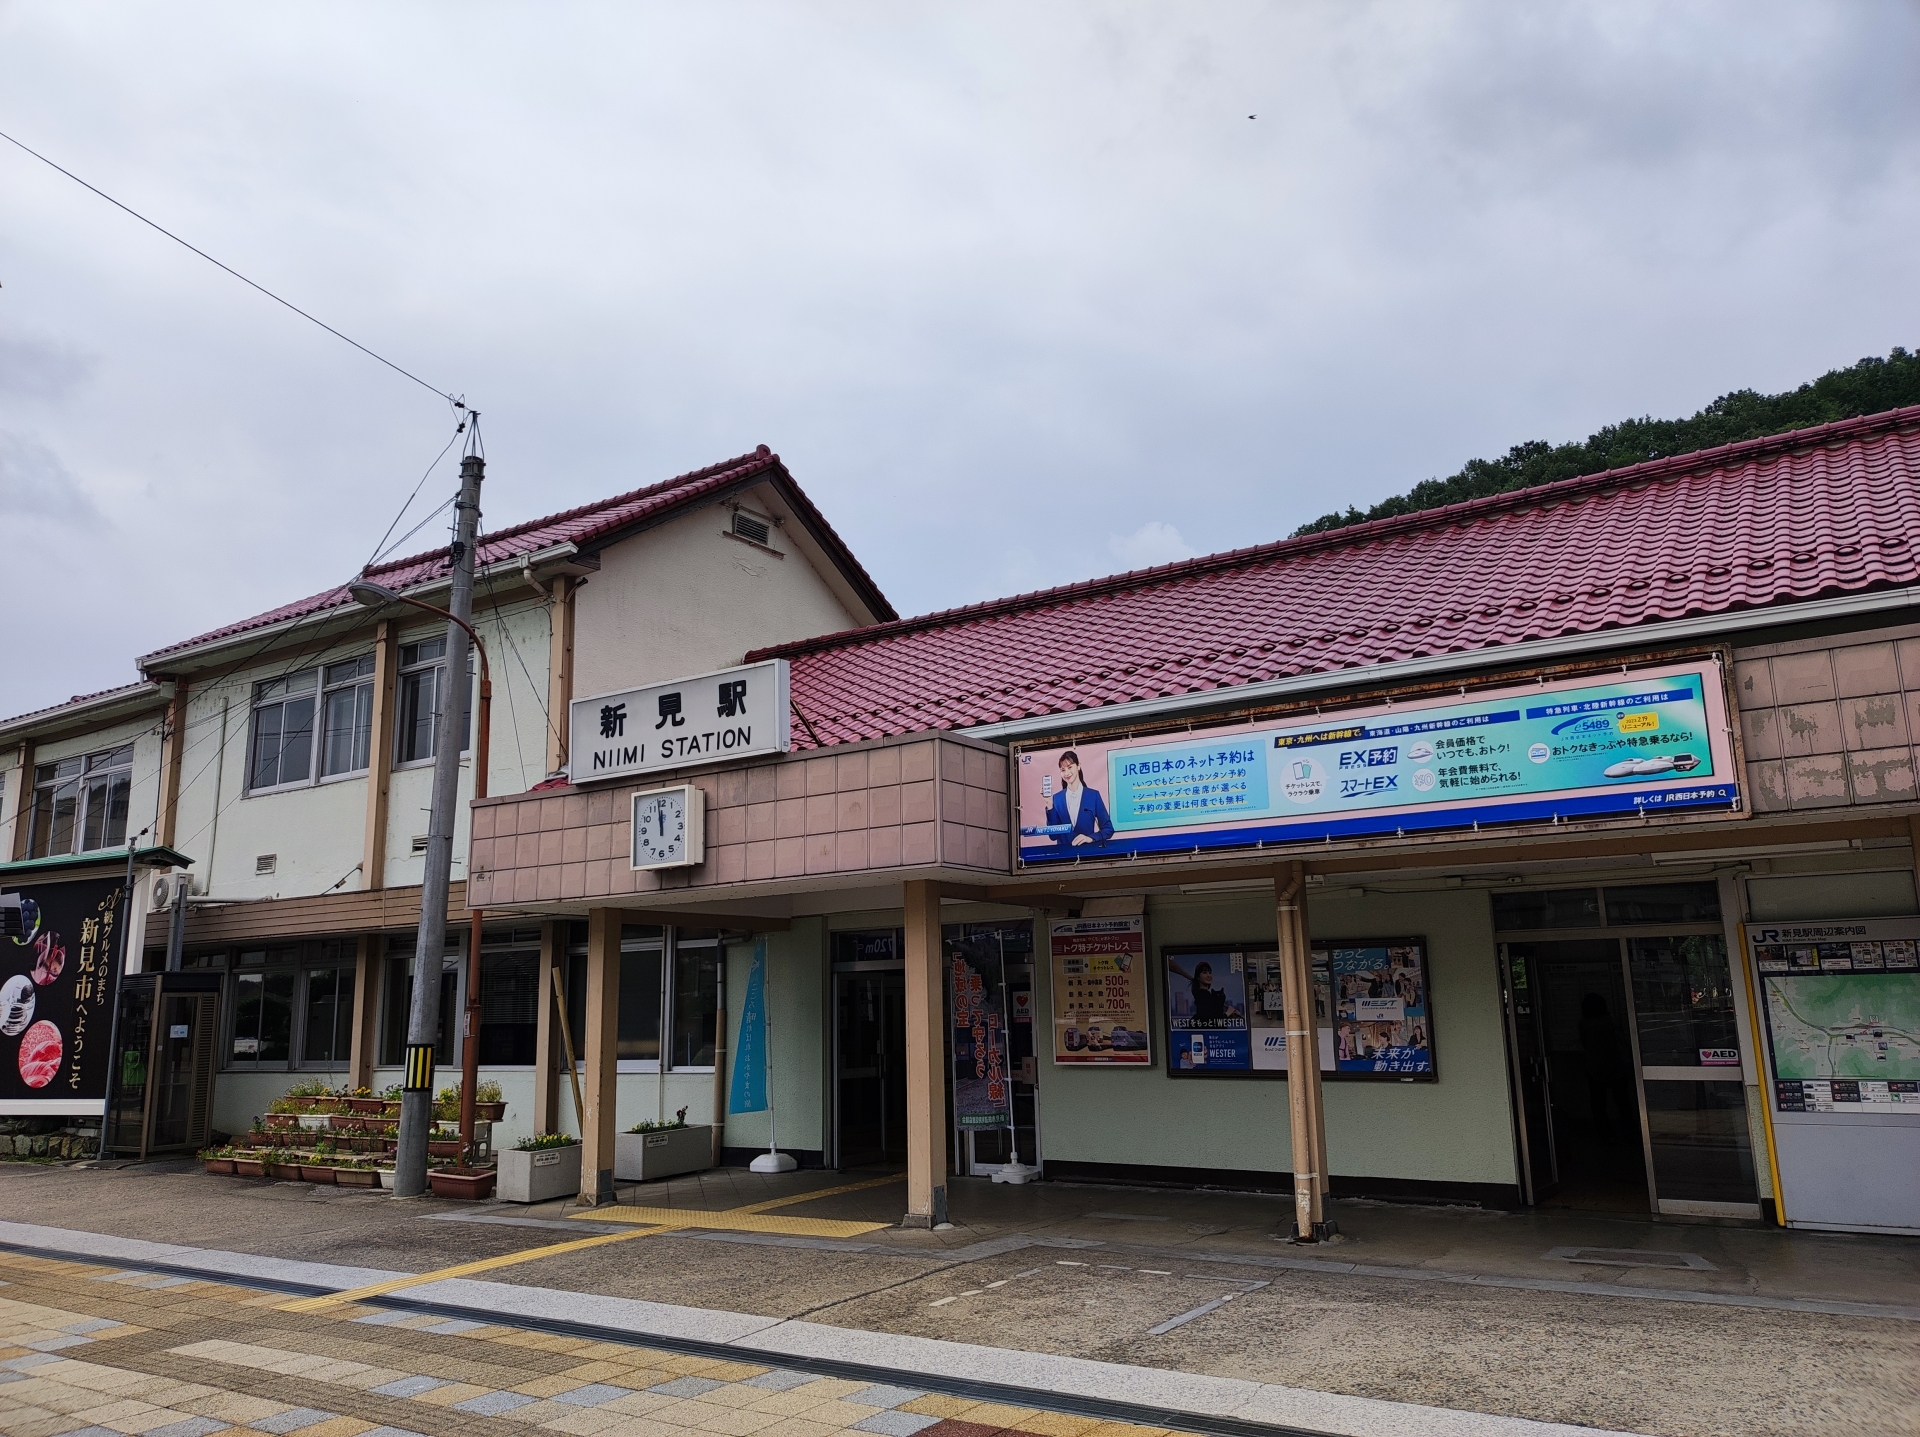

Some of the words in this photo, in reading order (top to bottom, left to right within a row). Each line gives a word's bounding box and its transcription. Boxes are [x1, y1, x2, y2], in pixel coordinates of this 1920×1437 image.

[600, 679, 747, 738] 新見駅
[1574, 719, 1610, 732] e5489
[593, 744, 645, 770] NIIMI
[660, 726, 752, 758] STATION
[1436, 736, 1486, 750] 会員価格で
[1552, 732, 1693, 757] おトクなきっぷや特急乗るなら!
[1340, 748, 1398, 766] EX予約
[1436, 744, 1510, 760] いつでも、おトク!
[1122, 750, 1255, 776] JR西日本のネット予約は
[1438, 762, 1502, 777] 年会費無料で、
[1340, 775, 1398, 793] スマートEX
[1439, 772, 1521, 788] 気軽に始められる!
[1665, 790, 1715, 803] JR西日本予約
[1752, 929, 1779, 943] JR
[1782, 926, 1866, 938] 新見駅周辺案内図
[96, 887, 122, 1006] A級グルメのまち
[1064, 942, 1130, 953] トク特チケットレス
[1333, 948, 1366, 960] もっと
[1333, 959, 1389, 971] つながる。
[1105, 976, 1129, 986] 500円
[1106, 987, 1130, 997] 700円
[68, 917, 100, 1090] 新見市へようこそ
[1106, 999, 1130, 1009] 700円
[1210, 1049, 1236, 1057] WESTER
[1371, 1047, 1417, 1060] 未来が
[1372, 1060, 1430, 1073] 動き出す。
